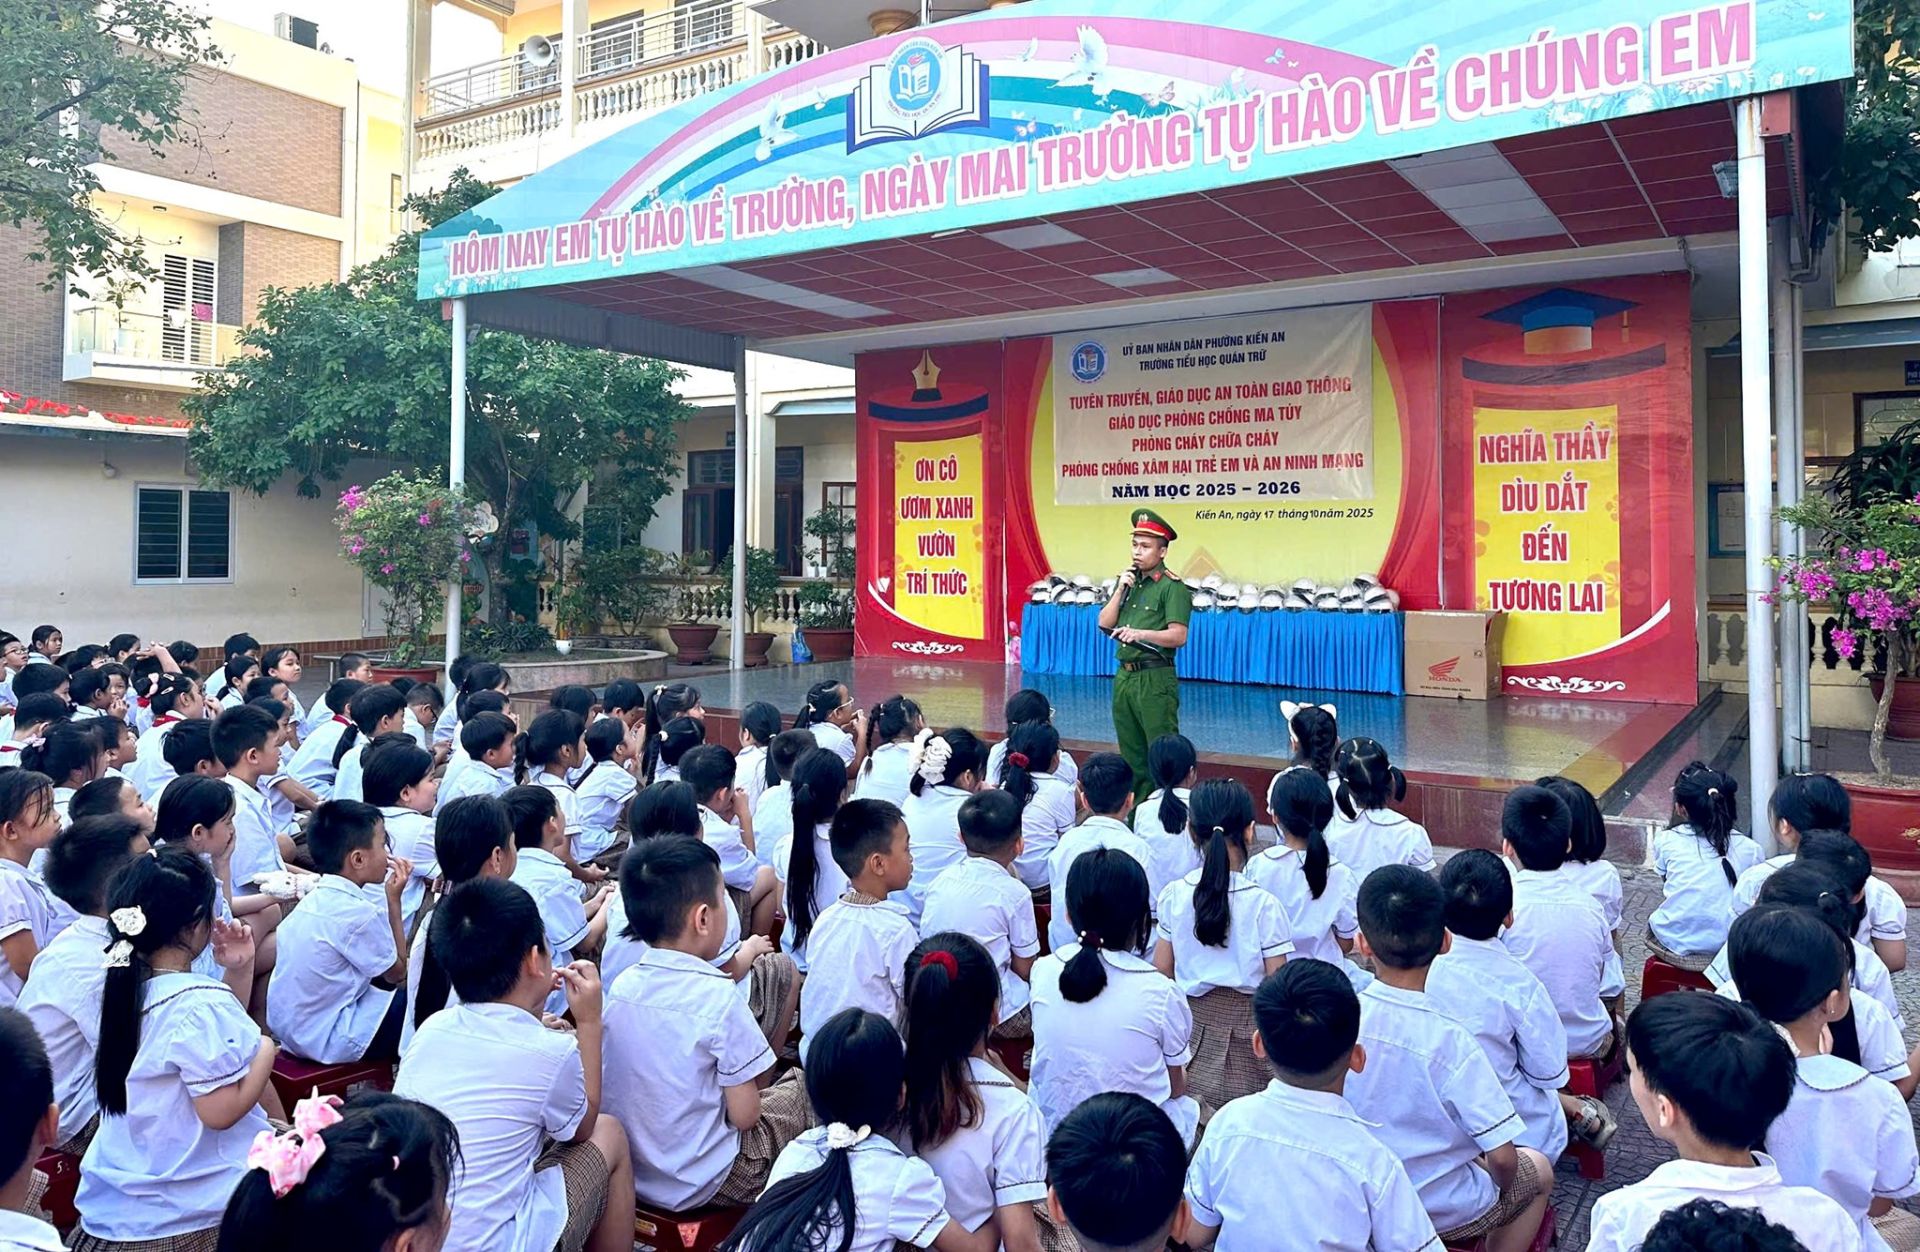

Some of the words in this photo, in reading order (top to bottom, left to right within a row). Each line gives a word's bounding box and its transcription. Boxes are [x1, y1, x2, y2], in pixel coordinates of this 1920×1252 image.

[451, 229, 500, 275] HÔM
[506, 234, 548, 269] NAY
[555, 224, 590, 262] EM
[600, 213, 630, 261] TỰ
[635, 200, 684, 252] HÀO
[693, 185, 725, 241] VỀ
[732, 177, 854, 235] TRƯỜNG,
[864, 155, 949, 216] NGÀY
[960, 144, 1026, 200] MAI
[1038, 110, 1191, 187] TRƯỜNG
[1204, 94, 1262, 166] TỰ
[1271, 74, 1363, 146] HÀO
[1378, 47, 1437, 127] VỀ
[1453, 25, 1639, 113] CHÚNG
[1660, 1, 1751, 76] EM
[1136, 343, 1154, 355] BAN
[1156, 339, 1181, 353] NHÂN
[1184, 337, 1203, 350] DÂN
[1205, 334, 1243, 349] PHƯỜNG
[1246, 330, 1269, 345] KIẾN
[1271, 331, 1285, 342] AN
[1139, 357, 1174, 371] TRƯỜNG
[1176, 353, 1196, 368] TIỂU
[1198, 355, 1217, 368] HỌC
[1069, 393, 1104, 410] TUYÊN
[1106, 387, 1153, 408] TRUYỀN,
[1156, 386, 1184, 405] GIÁO
[1187, 387, 1211, 405] DỤC
[1214, 385, 1232, 401] AN
[1235, 381, 1268, 399] TOÀN
[1272, 380, 1302, 397] GIAO
[1306, 375, 1352, 394] THÔNG
[1108, 413, 1135, 430] GIÁO
[1138, 414, 1161, 431] DỤC
[1164, 409, 1205, 427] PHÒNG
[1208, 405, 1251, 425] CHỐNG
[1254, 407, 1275, 422] MA
[1278, 402, 1302, 421] TÚY
[1132, 434, 1172, 452] PHÒNG
[1175, 433, 1206, 450] CHÁY
[1209, 431, 1242, 449] CHỮA
[1245, 429, 1279, 447] CHÁY
[1479, 428, 1547, 463] NGHĨA
[1553, 421, 1611, 461] THẦY
[915, 459, 935, 482] ƠN
[938, 454, 957, 482] CÔ
[1062, 460, 1098, 477] PHÒNG
[1101, 457, 1139, 476] CHỐNG
[1142, 457, 1169, 475] XÂM
[1172, 460, 1192, 477] HẠI
[1195, 454, 1217, 473] TRẺ
[1220, 457, 1240, 472] EM
[1243, 454, 1260, 471] VÀ
[1263, 456, 1281, 471] AN
[1285, 454, 1318, 470] NINH
[1321, 452, 1364, 471] MẠNG
[1112, 483, 1149, 498] NĂM
[1154, 484, 1190, 500] HỌC
[1195, 483, 1237, 497] 2025
[1257, 481, 1301, 495] 2026
[1501, 477, 1538, 511] DÌU
[1545, 471, 1588, 511] DẮT
[901, 497, 931, 519] ƯƠM
[935, 496, 973, 519] XANH
[1195, 508, 1216, 520] Kiến
[1218, 509, 1234, 521] An,
[1236, 509, 1261, 522] ngày
[1264, 510, 1274, 519] 17
[1346, 508, 1374, 518] 2025
[918, 530, 956, 556] VƯỜN
[1522, 523, 1567, 561] ĐẾN
[906, 568, 927, 595] TRÍ
[931, 569, 967, 595] THỨC
[1489, 579, 1561, 611] TƯƠNG
[1569, 584, 1604, 612] LAI
